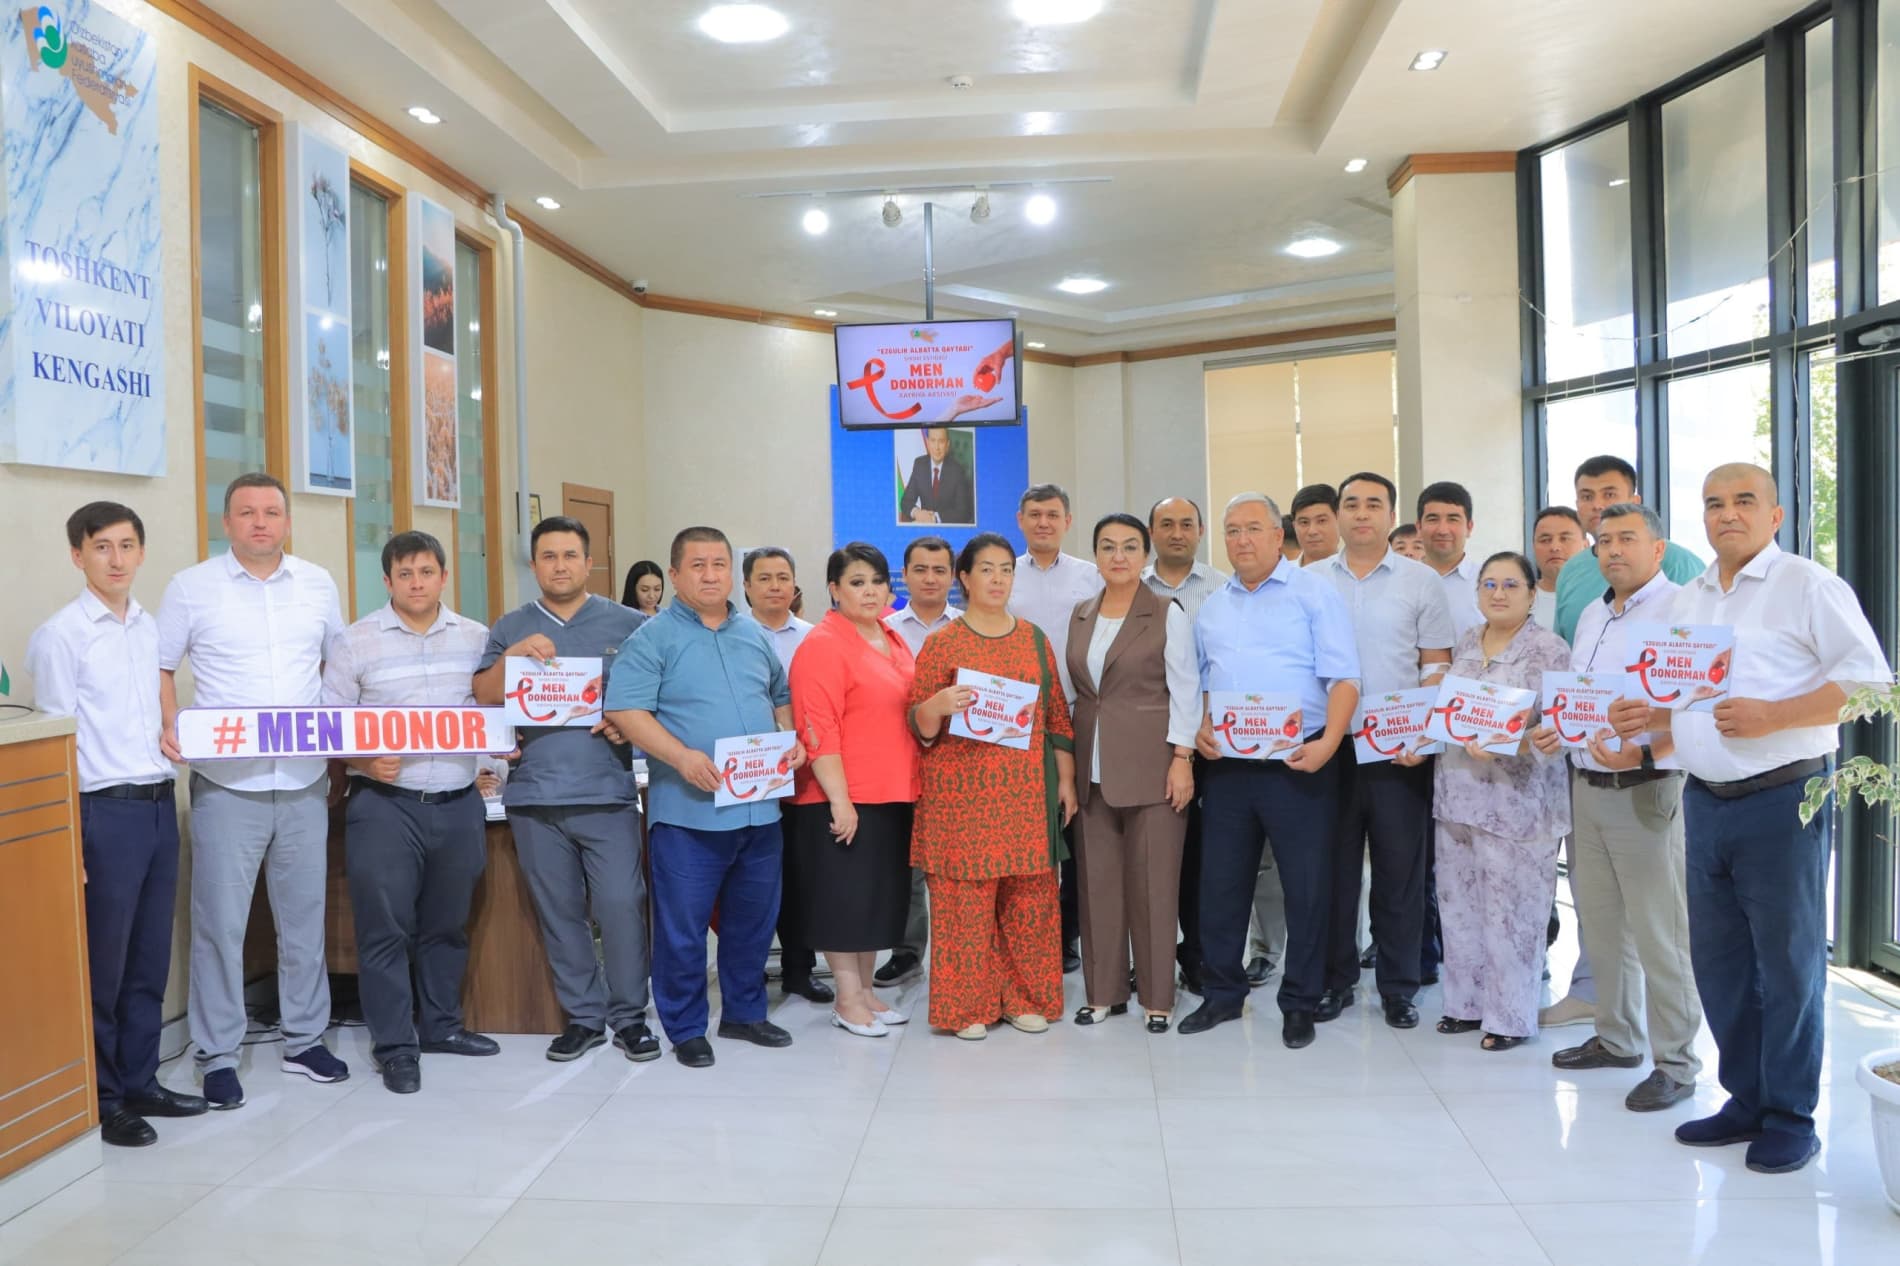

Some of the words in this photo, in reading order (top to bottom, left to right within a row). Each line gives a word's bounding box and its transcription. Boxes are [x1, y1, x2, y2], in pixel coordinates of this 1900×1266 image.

[25, 239, 151, 301] TOSHKENT
[36, 297, 145, 348] VILOYATI
[33, 351, 151, 398] KENGASHI
[909, 363, 943, 377] MEN
[890, 377, 964, 391] DONORMAN
[1666, 656, 1692, 668] MEN
[1650, 668, 1706, 681] DONORMAN
[542, 683, 565, 693] MEN
[528, 694, 580, 702] DONORMAN
[984, 700, 1005, 712] MEN
[1471, 706, 1494, 718] MEN
[1575, 701, 1595, 711] MEN
[971, 707, 1015, 723] DONORMAN
[1386, 715, 1409, 727] MEN
[1454, 713, 1505, 729] DONORMAN
[1562, 712, 1606, 723] DONORMAN
[1244, 718, 1267, 727] MEN
[353, 710, 488, 751] DONOR
[1232, 727, 1281, 736] DONORMAN
[1375, 724, 1424, 738] DONORMAN
[744, 759, 764, 770] MEN
[733, 768, 776, 781] DONORMAN
